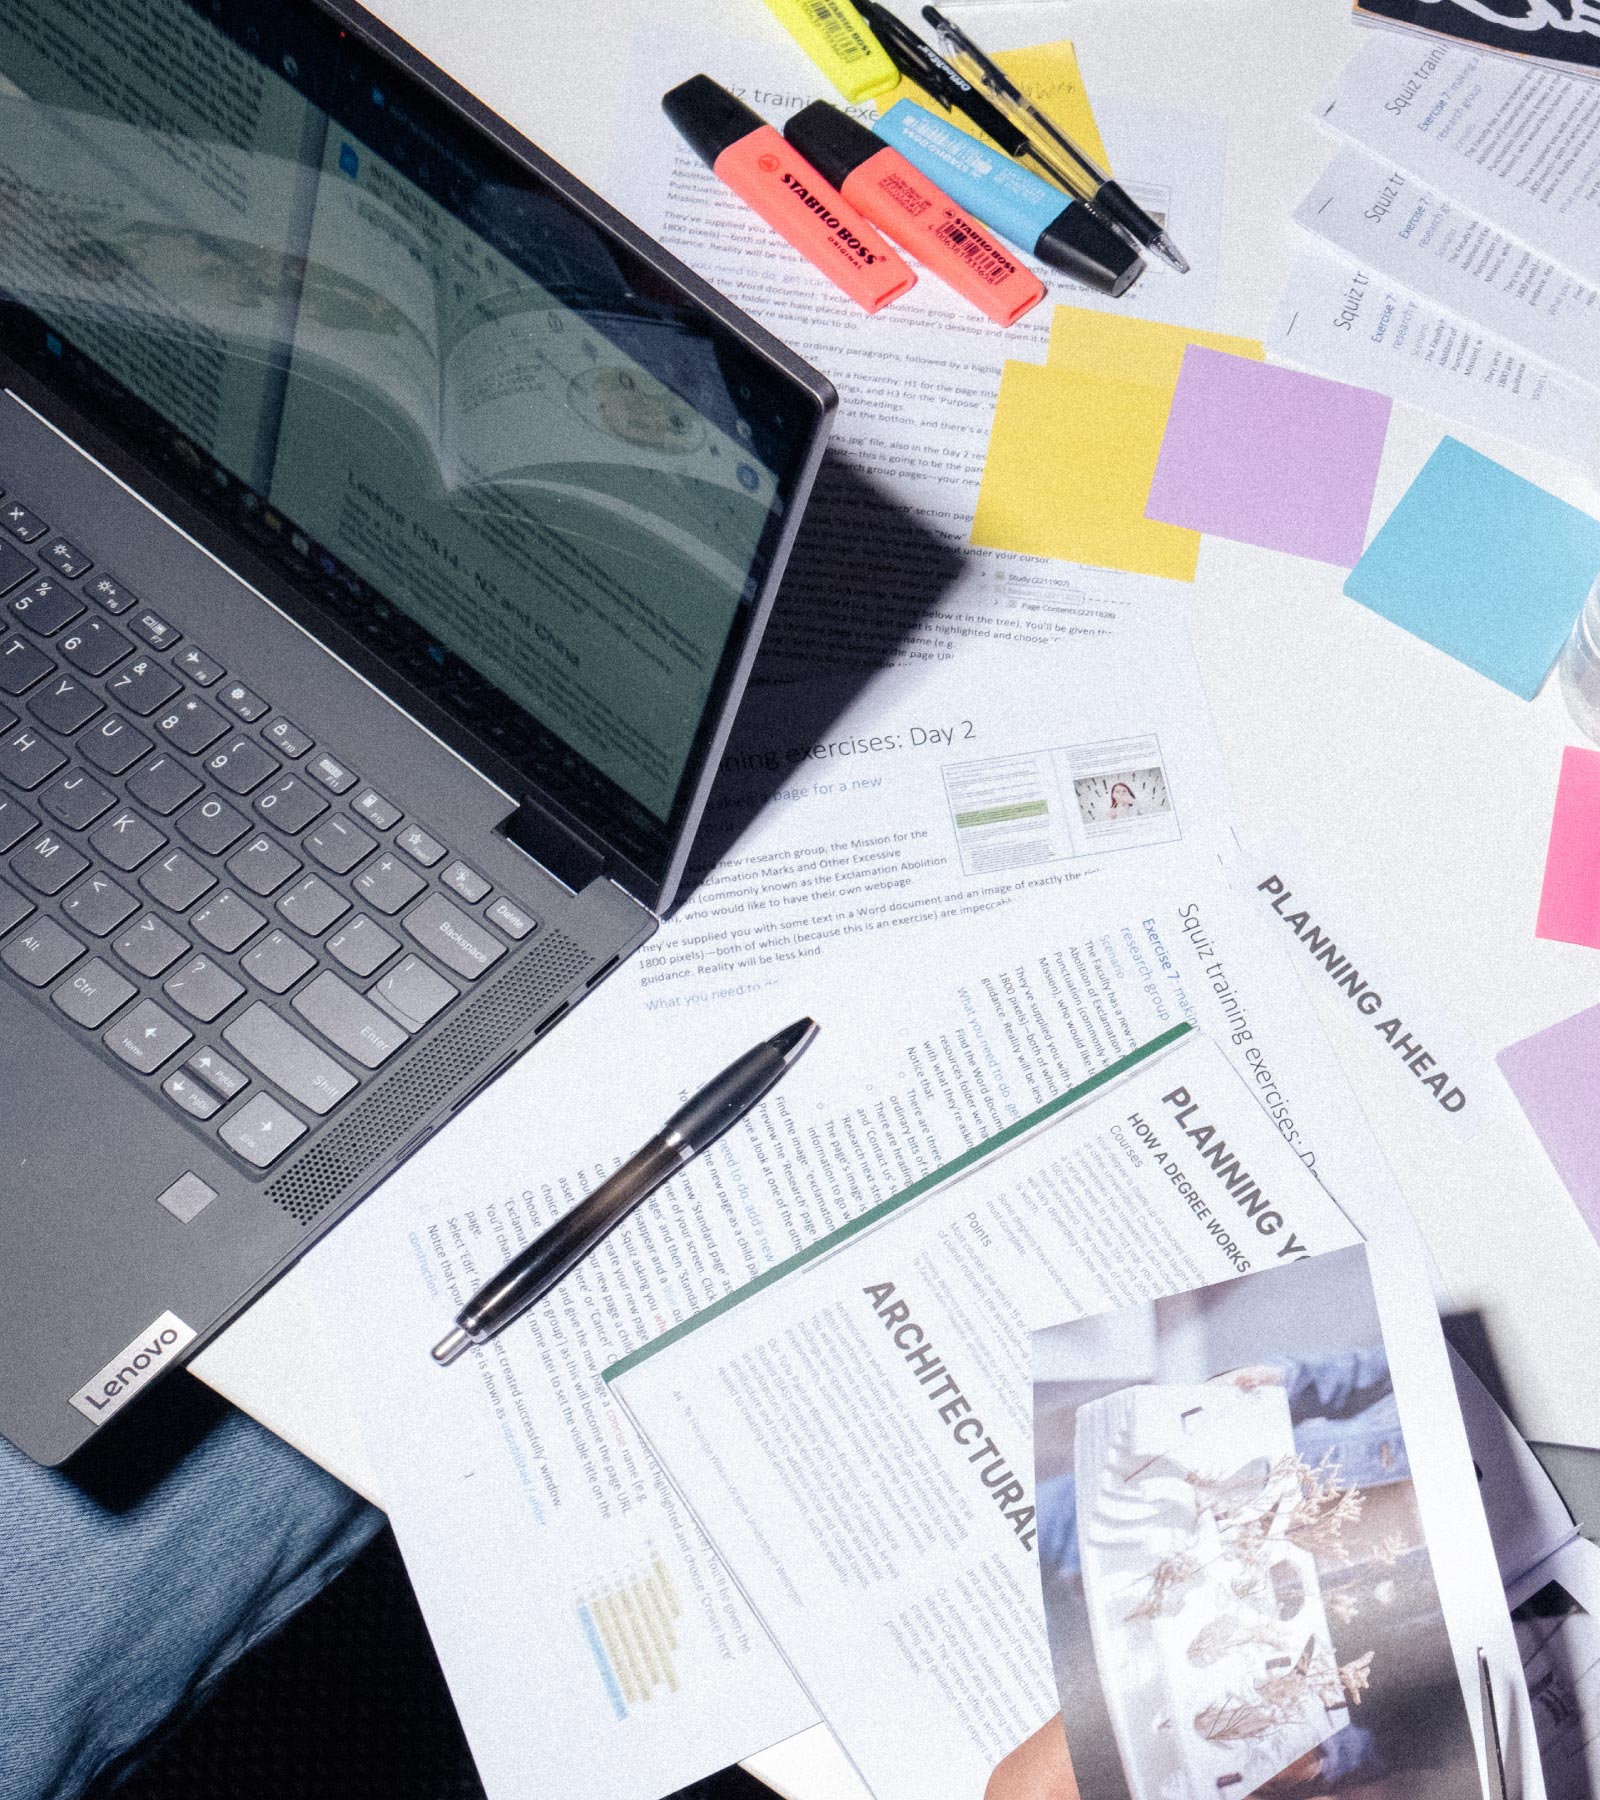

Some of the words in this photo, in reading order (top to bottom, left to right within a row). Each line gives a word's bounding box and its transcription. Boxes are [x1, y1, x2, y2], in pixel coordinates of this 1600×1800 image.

[1384, 79, 1421, 115] Squiz
[1435, 107, 1464, 141] research
[1461, 84, 1482, 110] group
[1416, 99, 1447, 131] Exercise
[781, 173, 839, 228] STABILO
[836, 227, 876, 264] BOSS
[1363, 188, 1396, 223] Squiz
[1397, 205, 1425, 239] Exercise
[827, 236, 861, 269] ORIGINAL
[954, 218, 992, 251] STABILO
[990, 250, 1015, 273] BOSS
[1332, 287, 1364, 331] Squiz
[1370, 304, 1394, 343] Exercise
[960, 545, 986, 559] under
[994, 547, 1019, 559] your
[15, 596, 32, 609] 5
[5, 640, 24, 654] T
[64, 636, 81, 649] 6
[55, 680, 73, 694] Y
[114, 674, 131, 686] 7
[101, 719, 122, 736] U
[161, 715, 178, 728] 8
[12, 733, 35, 751] H
[785, 733, 904, 765] exercises:
[909, 726, 953, 746] Day
[961, 719, 976, 739] 2
[211, 754, 227, 768] 9
[63, 777, 83, 789] J
[773, 786, 809, 803] page
[812, 782, 833, 794] for
[838, 782, 847, 792] a
[851, 777, 882, 789] new
[112, 814, 134, 832] K
[34, 837, 59, 857] M
[248, 839, 268, 851] P
[717, 857, 738, 868] new
[745, 850, 791, 863] research
[793, 846, 827, 859] group,
[830, 842, 847, 851] the
[850, 835, 890, 848] Mission
[892, 832, 907, 841] for
[910, 830, 927, 839] the
[163, 854, 177, 871] L
[760, 865, 794, 877] Marks
[796, 860, 816, 872] and
[818, 857, 849, 868] Other
[852, 849, 900, 863] Excessive
[697, 886, 758, 904] (commonly
[761, 880, 797, 892] known
[800, 878, 812, 887] as
[814, 875, 832, 884] the
[834, 865, 897, 881] Exclamation
[900, 857, 947, 870] Abolition
[496, 905, 523, 928] Delete
[22, 934, 40, 952] Alt
[439, 921, 487, 962] Backspace
[1082, 939, 1097, 958] The
[1098, 933, 1124, 978] Scenario
[1141, 917, 1171, 970] Exercise
[1068, 946, 1091, 987] Abolition
[1092, 958, 1111, 990] Faculty
[1120, 926, 1153, 981] research
[1143, 982, 1170, 1021] group
[1177, 903, 1214, 960] Squiz
[1205, 962, 1253, 1045] training
[73, 977, 96, 996] Ctrl
[1087, 987, 1099, 997] of
[1105, 990, 1120, 1010] has
[1256, 874, 1381, 1015] PLANNING
[1374, 1017, 1465, 1112] AHEAD
[1053, 951, 1082, 1006] Punctuation
[1076, 1006, 1105, 1056] (commonly
[1114, 1009, 1125, 1020] a
[360, 1025, 389, 1050] Enter
[1057, 998, 1070, 1019] who
[1066, 1020, 1085, 1049] would
[1077, 1044, 1091, 1066] like
[1092, 998, 1121, 1053] Exclamation
[1118, 1016, 1131, 1036] new
[122, 1037, 143, 1056] Home
[312, 1074, 339, 1097] Shift
[1109, 1124, 1143, 1168] Courses
[1161, 1085, 1283, 1235] PLANNING
[1127, 1112, 1161, 1149] HOW
[1153, 1149, 1169, 1165] A
[1163, 1162, 1211, 1220] DEGREE
[1206, 1218, 1250, 1272] WORKS
[964, 1211, 992, 1247] Points
[84, 1329, 177, 1410] Lenovo
[862, 1282, 1039, 1551] ARCHITECTURAL
